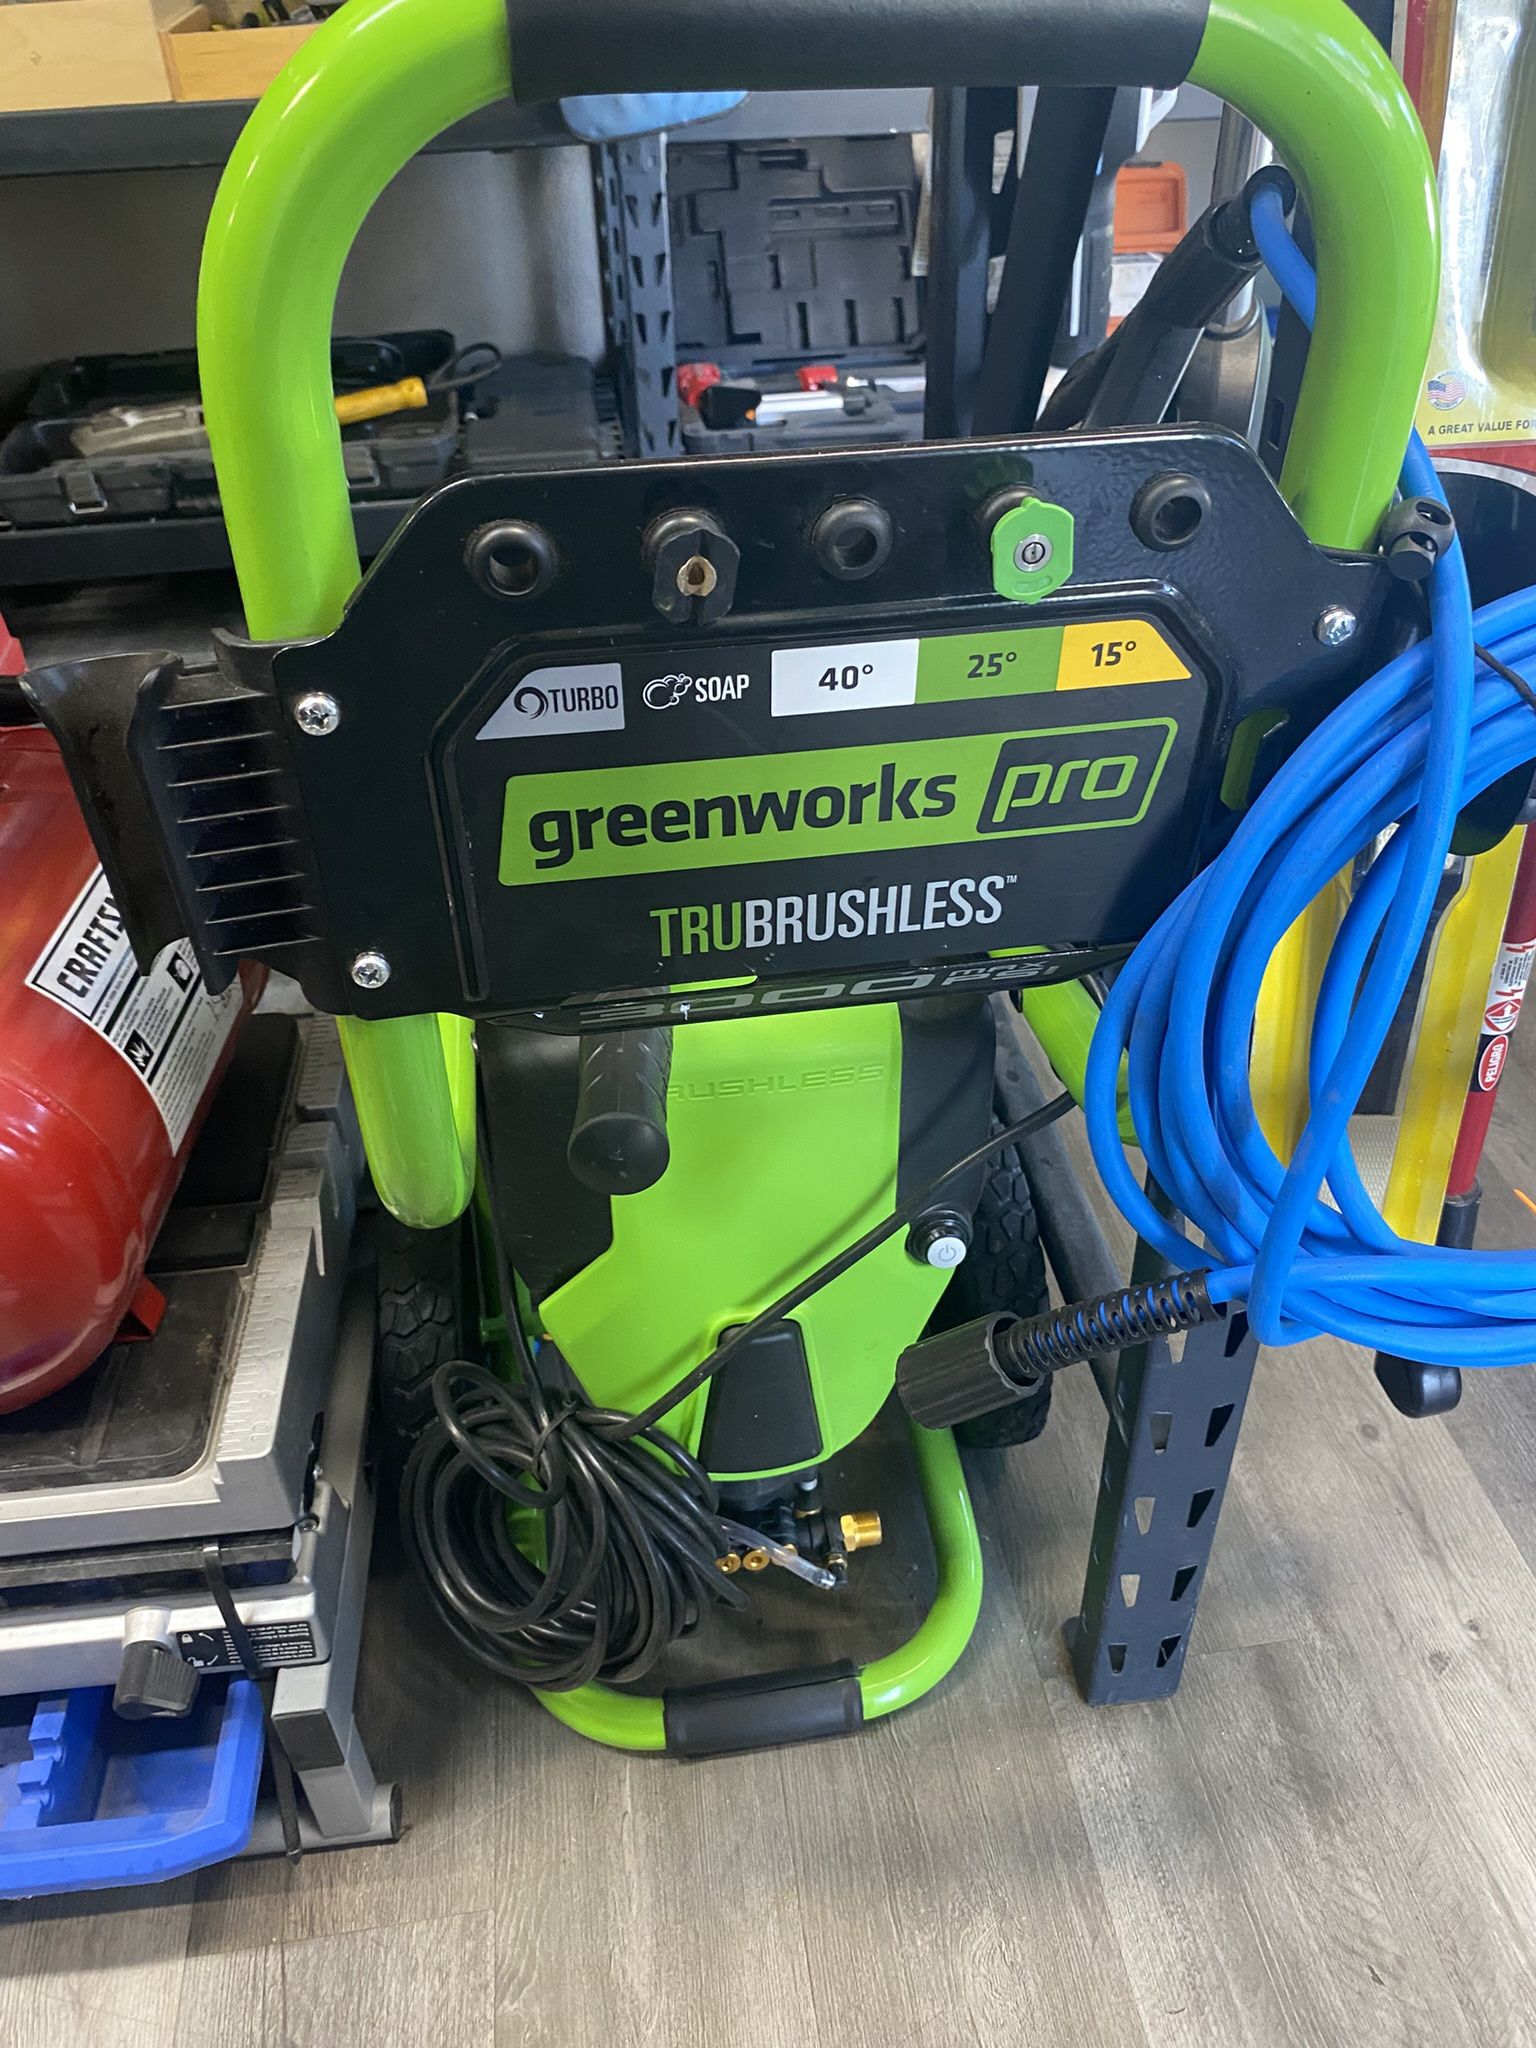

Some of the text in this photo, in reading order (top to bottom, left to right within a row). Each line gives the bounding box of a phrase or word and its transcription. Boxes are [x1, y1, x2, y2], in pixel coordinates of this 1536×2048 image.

[1427, 425, 1435, 436] A
[1438, 423, 1474, 435] GREAT
[1478, 420, 1512, 432] VALUE
[966, 651, 1018, 679] 25°
[1090, 640, 1137, 668] 15°
[694, 673, 750, 703] SOAP
[817, 663, 874, 692] 40°
[548, 684, 619, 714] TURBO
[528, 754, 1140, 870] greenworks pro
[579, 972, 936, 1024] 3000
[941, 965, 1060, 987] PSI
[1484, 1043, 1506, 1084] PELIGRO
